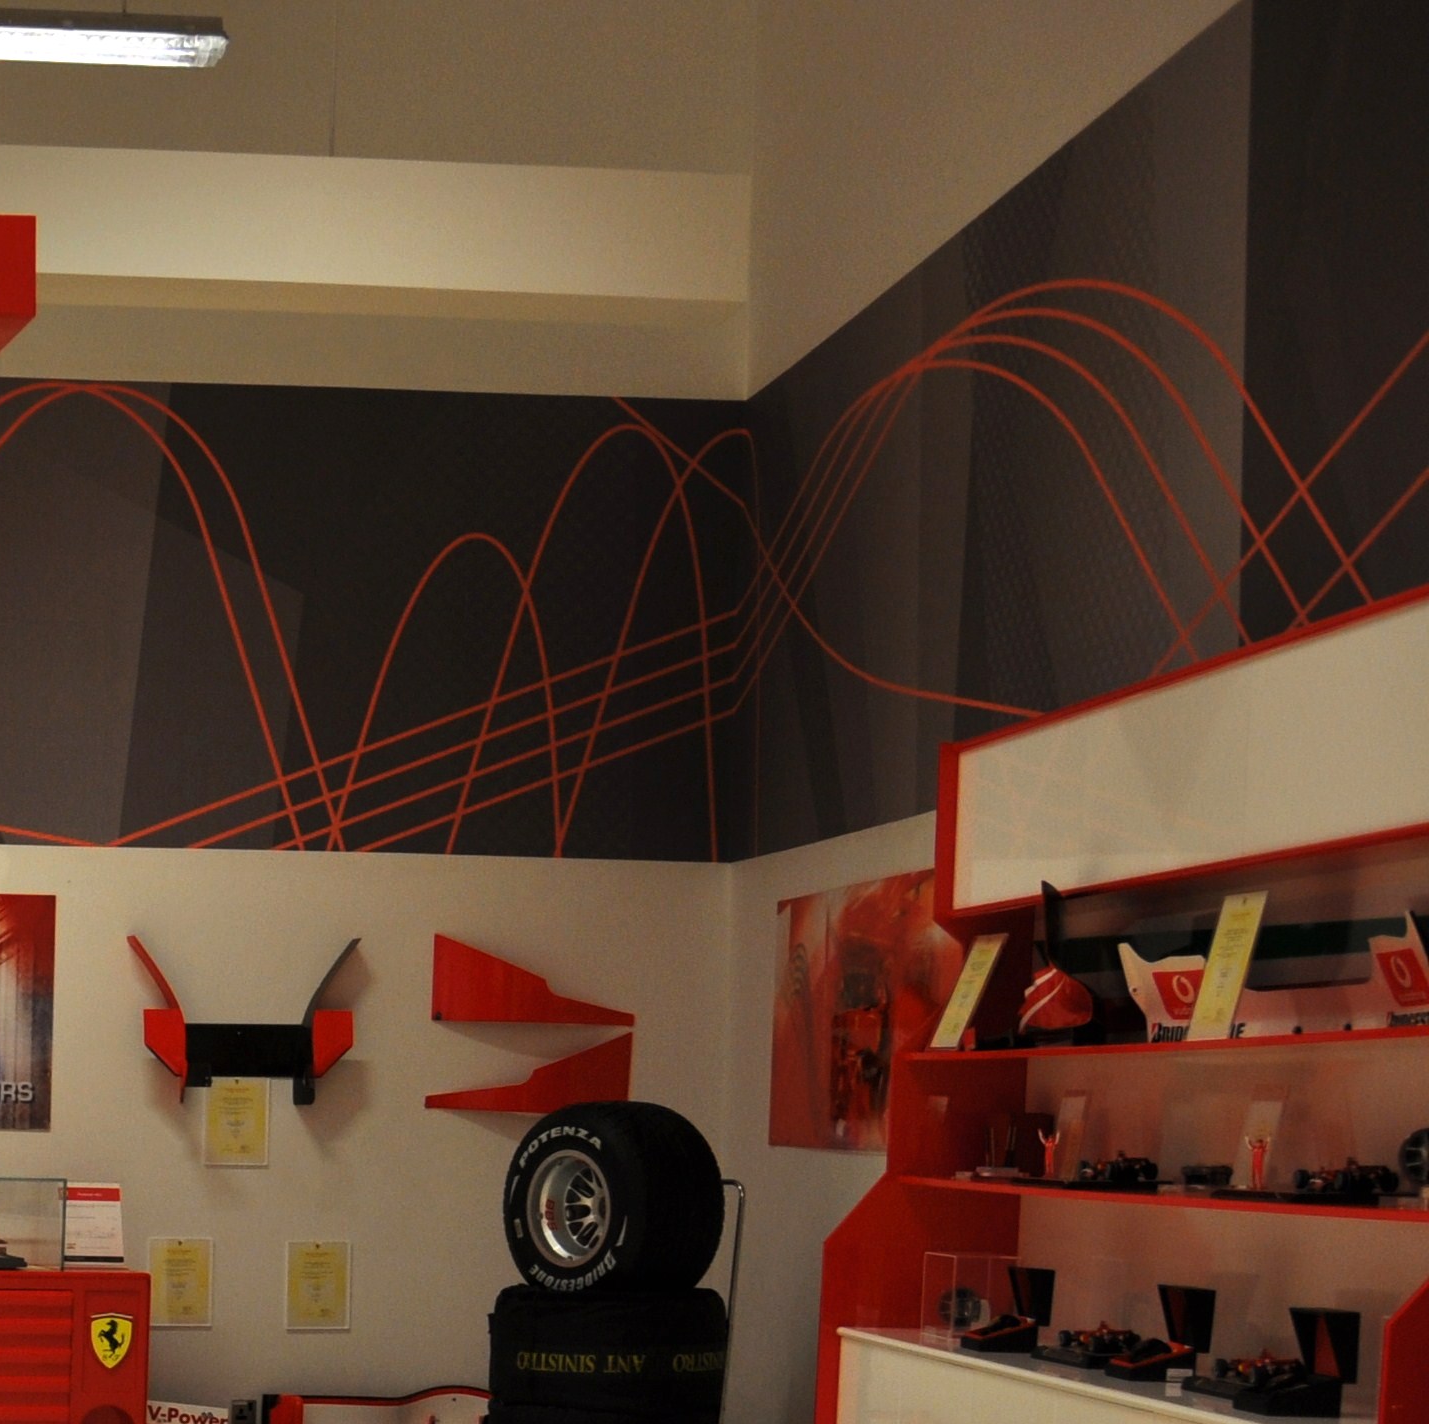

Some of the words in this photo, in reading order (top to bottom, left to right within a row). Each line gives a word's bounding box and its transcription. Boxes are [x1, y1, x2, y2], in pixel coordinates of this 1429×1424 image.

[518, 1125, 603, 1168] POTENZA
[529, 1250, 617, 1292] BRIDGESTONE
[603, 1354, 647, 1373] ANT
